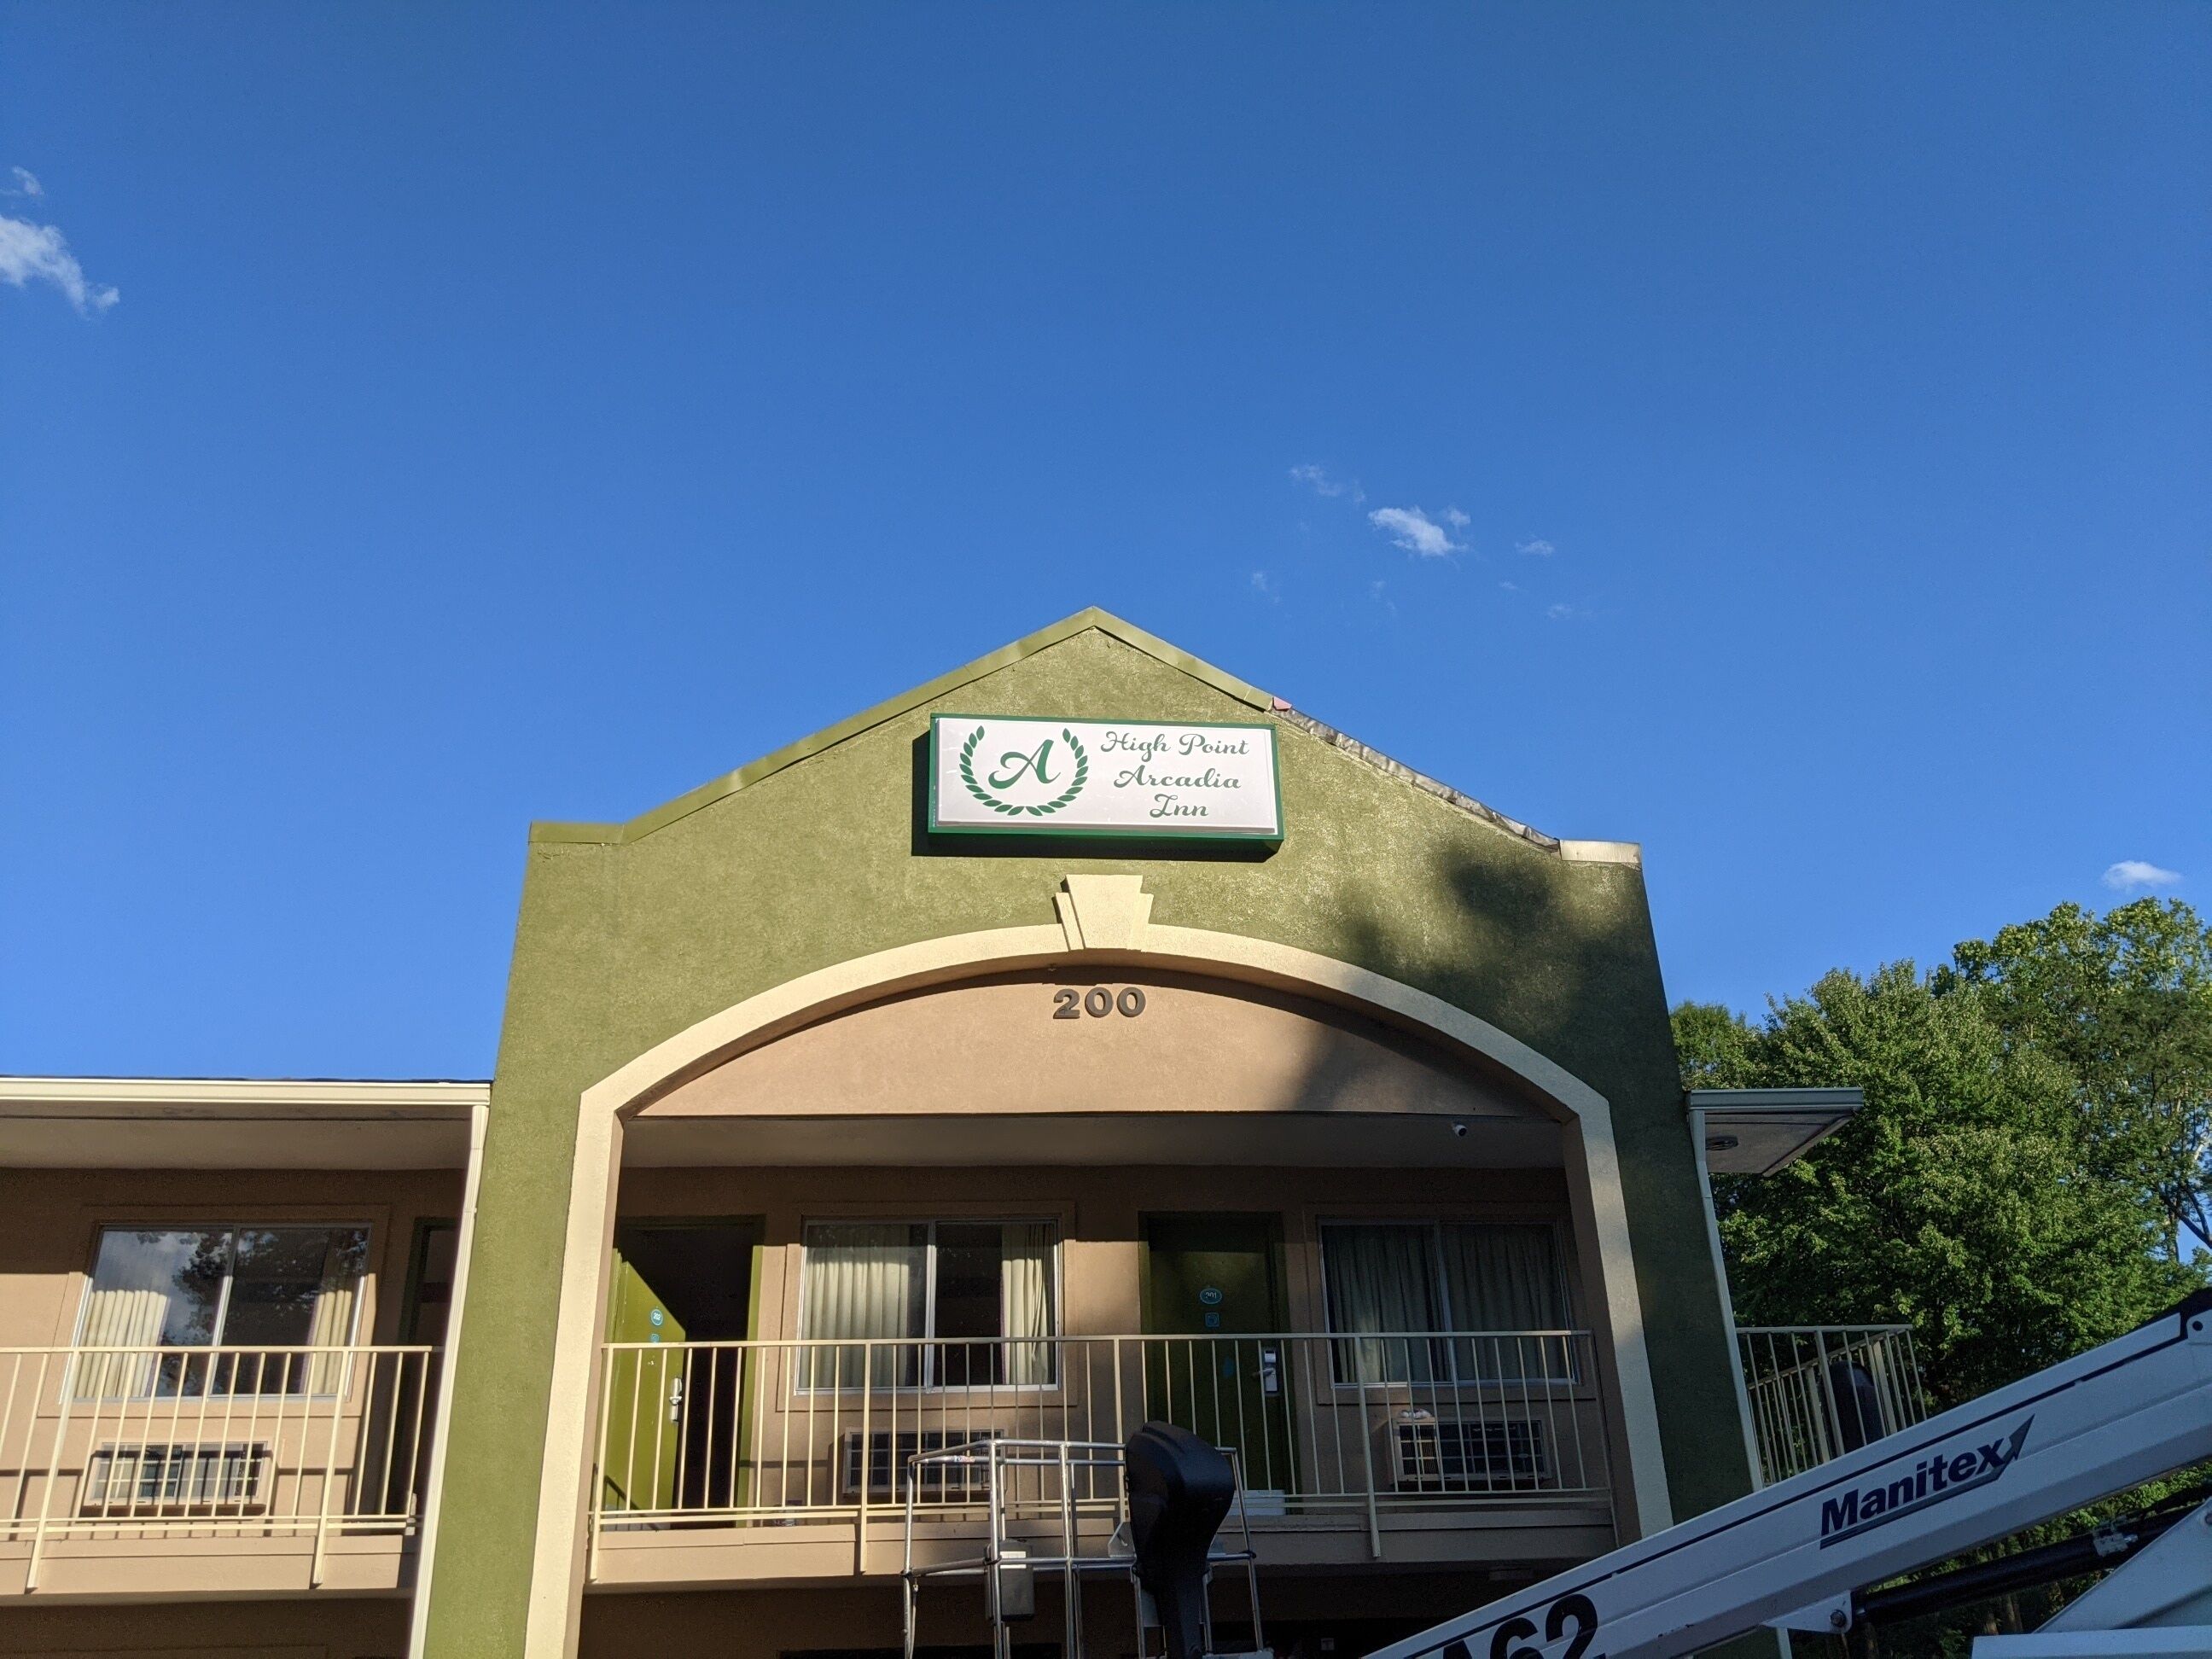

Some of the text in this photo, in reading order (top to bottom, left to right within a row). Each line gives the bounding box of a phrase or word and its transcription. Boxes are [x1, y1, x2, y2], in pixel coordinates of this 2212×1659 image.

[1100, 731, 1249, 762] High Point
[988, 739, 1061, 789] A
[1114, 764, 1241, 789] Arcadia
[1150, 793, 1208, 818] Inn
[1052, 987, 1147, 1019] 200
[1820, 1437, 2005, 1536] Manitex
[1442, 1593, 1606, 1659] 62
